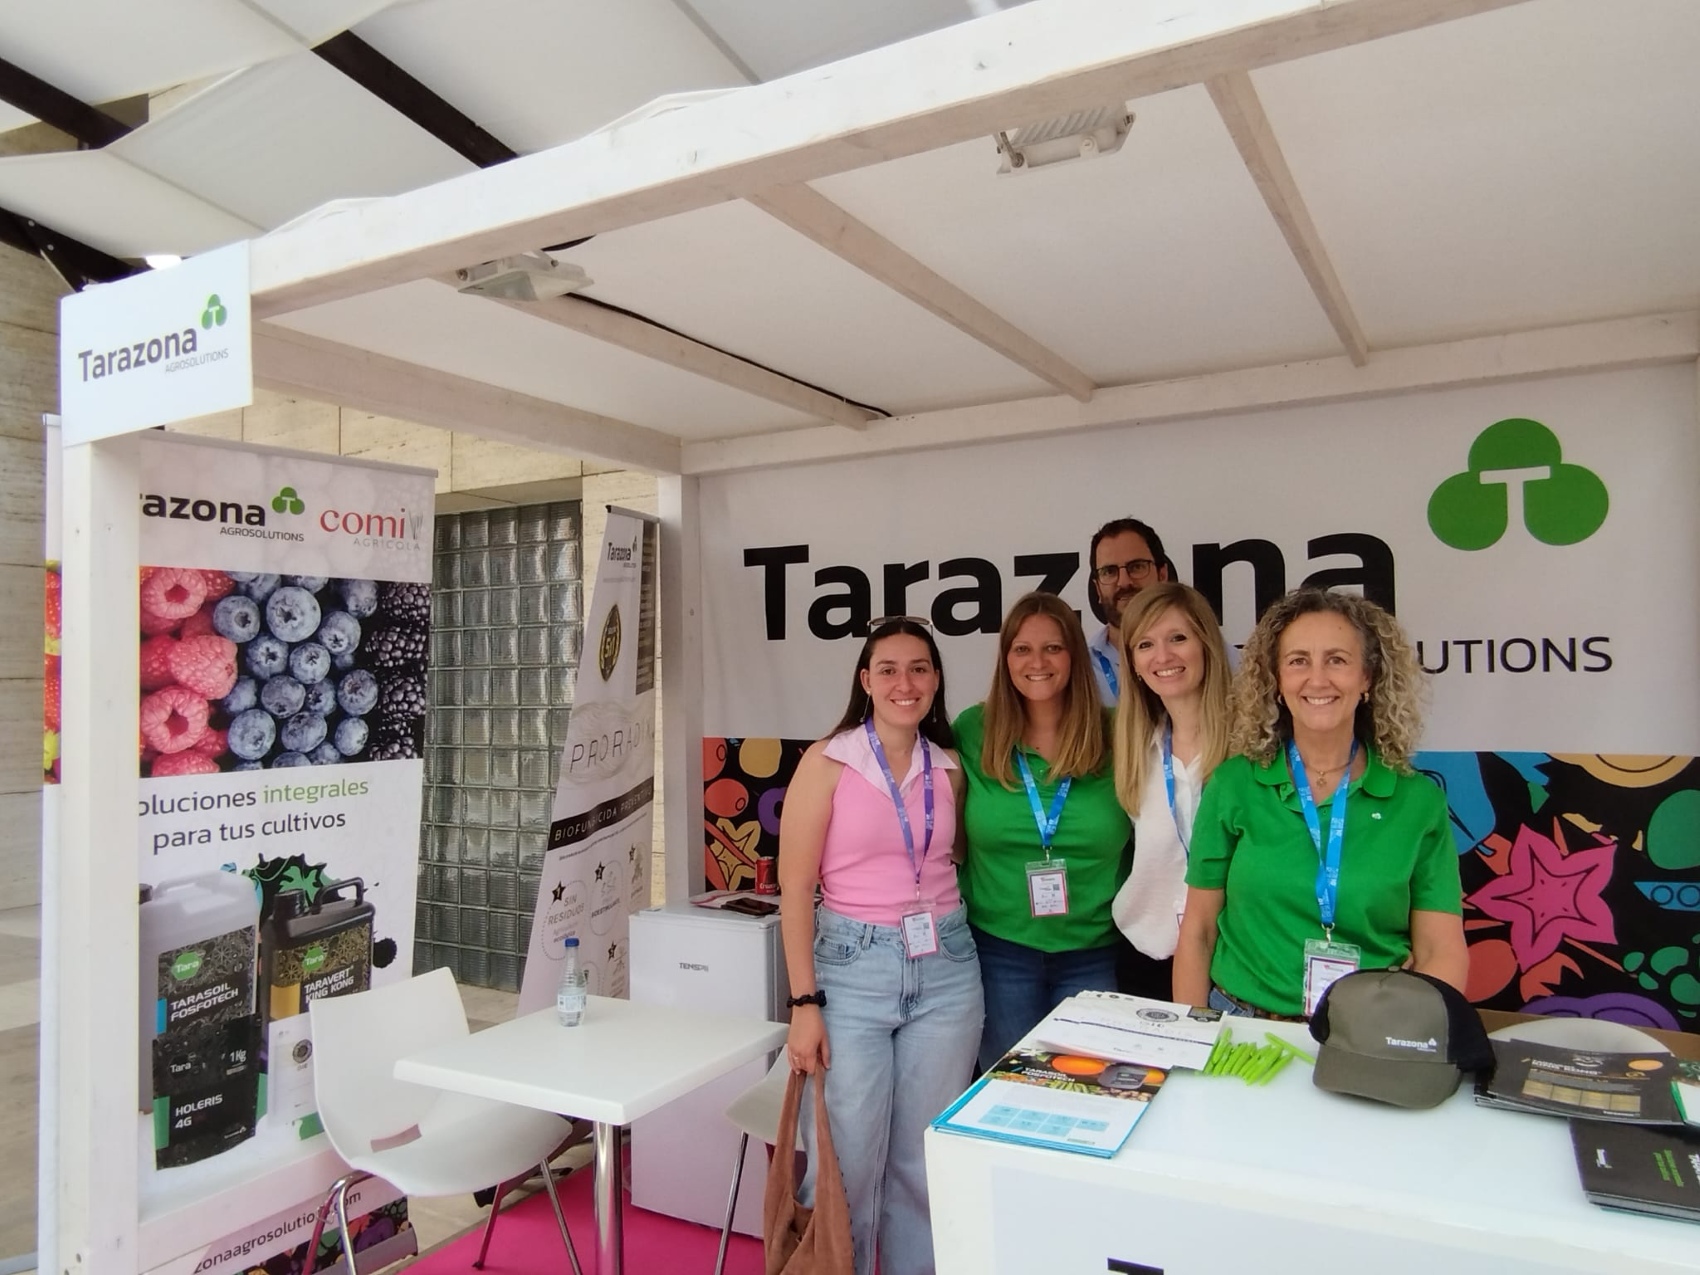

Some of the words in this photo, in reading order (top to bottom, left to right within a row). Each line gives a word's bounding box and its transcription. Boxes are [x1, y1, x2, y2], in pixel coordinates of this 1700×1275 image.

[78, 328, 197, 382] Tarazona
[165, 348, 229, 374] AGROSOLUTIONS
[139, 493, 266, 527] azona
[219, 526, 305, 542] AGROSOLUTIONS
[1416, 636, 1613, 675] UTIONS
[139, 791, 257, 816] oluciones
[263, 778, 369, 804] integrales
[153, 828, 212, 855] para
[219, 823, 255, 841] tus
[261, 812, 346, 836] cultivos
[175, 960, 200, 973] Tara
[305, 955, 324, 965] Tara
[304, 967, 352, 993] TARAVERT
[305, 987, 329, 1004] KING
[330, 976, 354, 993] KONG
[170, 982, 231, 1010] TARASOIL
[170, 988, 239, 1021] FOSFOTECH
[1385, 1036, 1429, 1049] Tarazona
[170, 1063, 192, 1074] Tara
[175, 1094, 223, 1117] HOLERIS
[174, 1116, 192, 1129] 4G
